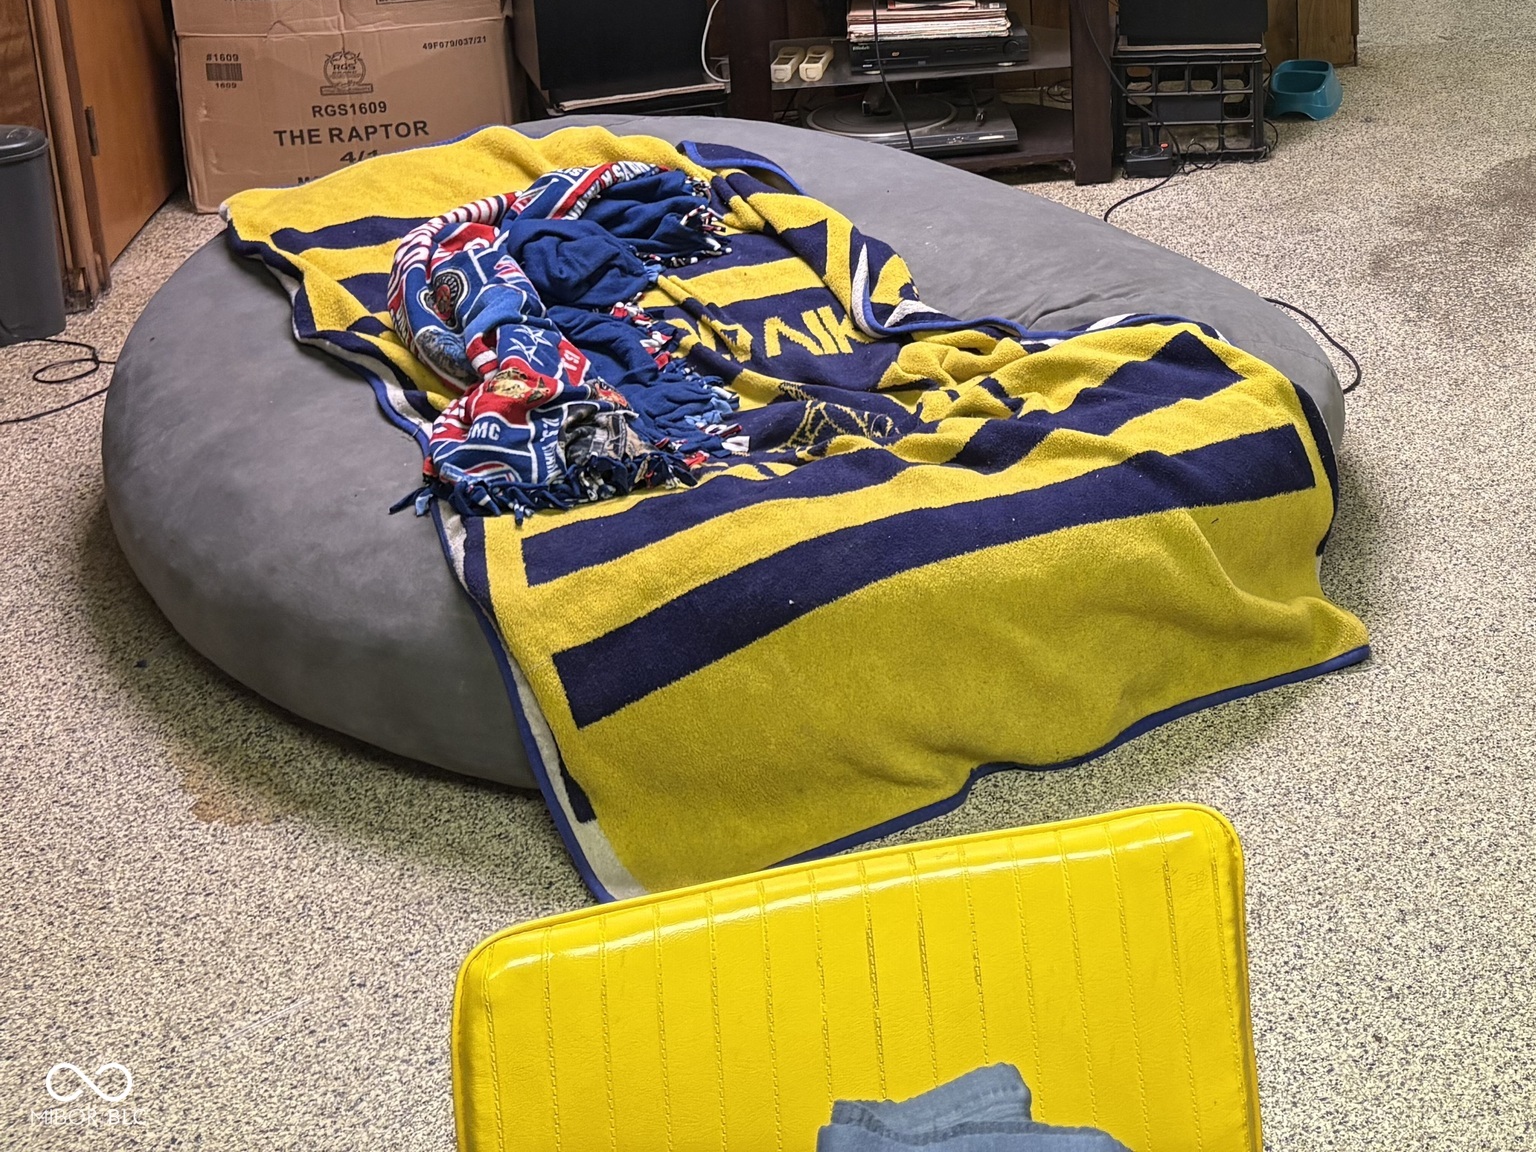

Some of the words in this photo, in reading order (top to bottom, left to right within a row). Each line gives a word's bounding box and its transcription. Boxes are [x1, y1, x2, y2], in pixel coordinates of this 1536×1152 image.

[206, 53, 239, 62] #1609
[312, 100, 387, 118] RGS1609
[273, 128, 323, 147] THE
[328, 119, 430, 143] RAPTOR
